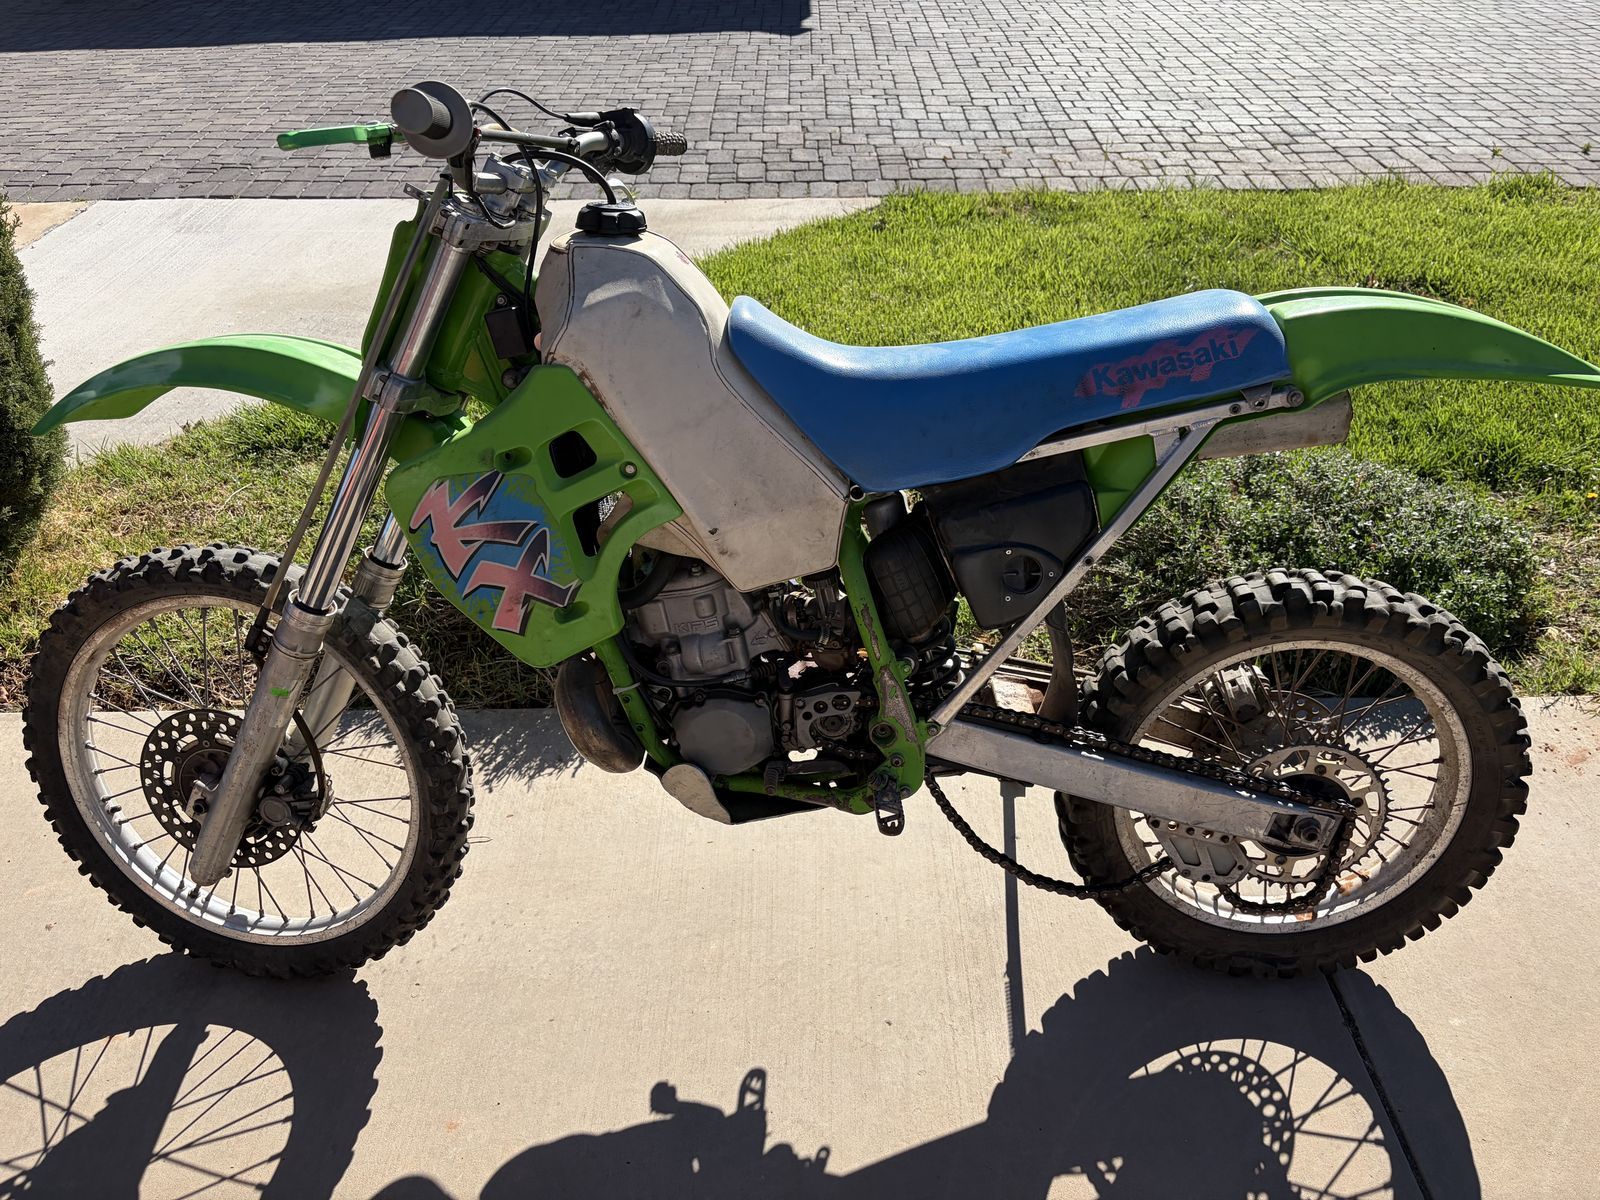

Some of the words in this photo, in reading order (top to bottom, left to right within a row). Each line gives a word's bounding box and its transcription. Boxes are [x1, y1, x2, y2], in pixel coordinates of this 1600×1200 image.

[1092, 336, 1240, 391] Kawasaki
[409, 468, 582, 636] KX
[674, 617, 719, 633] KIPS
